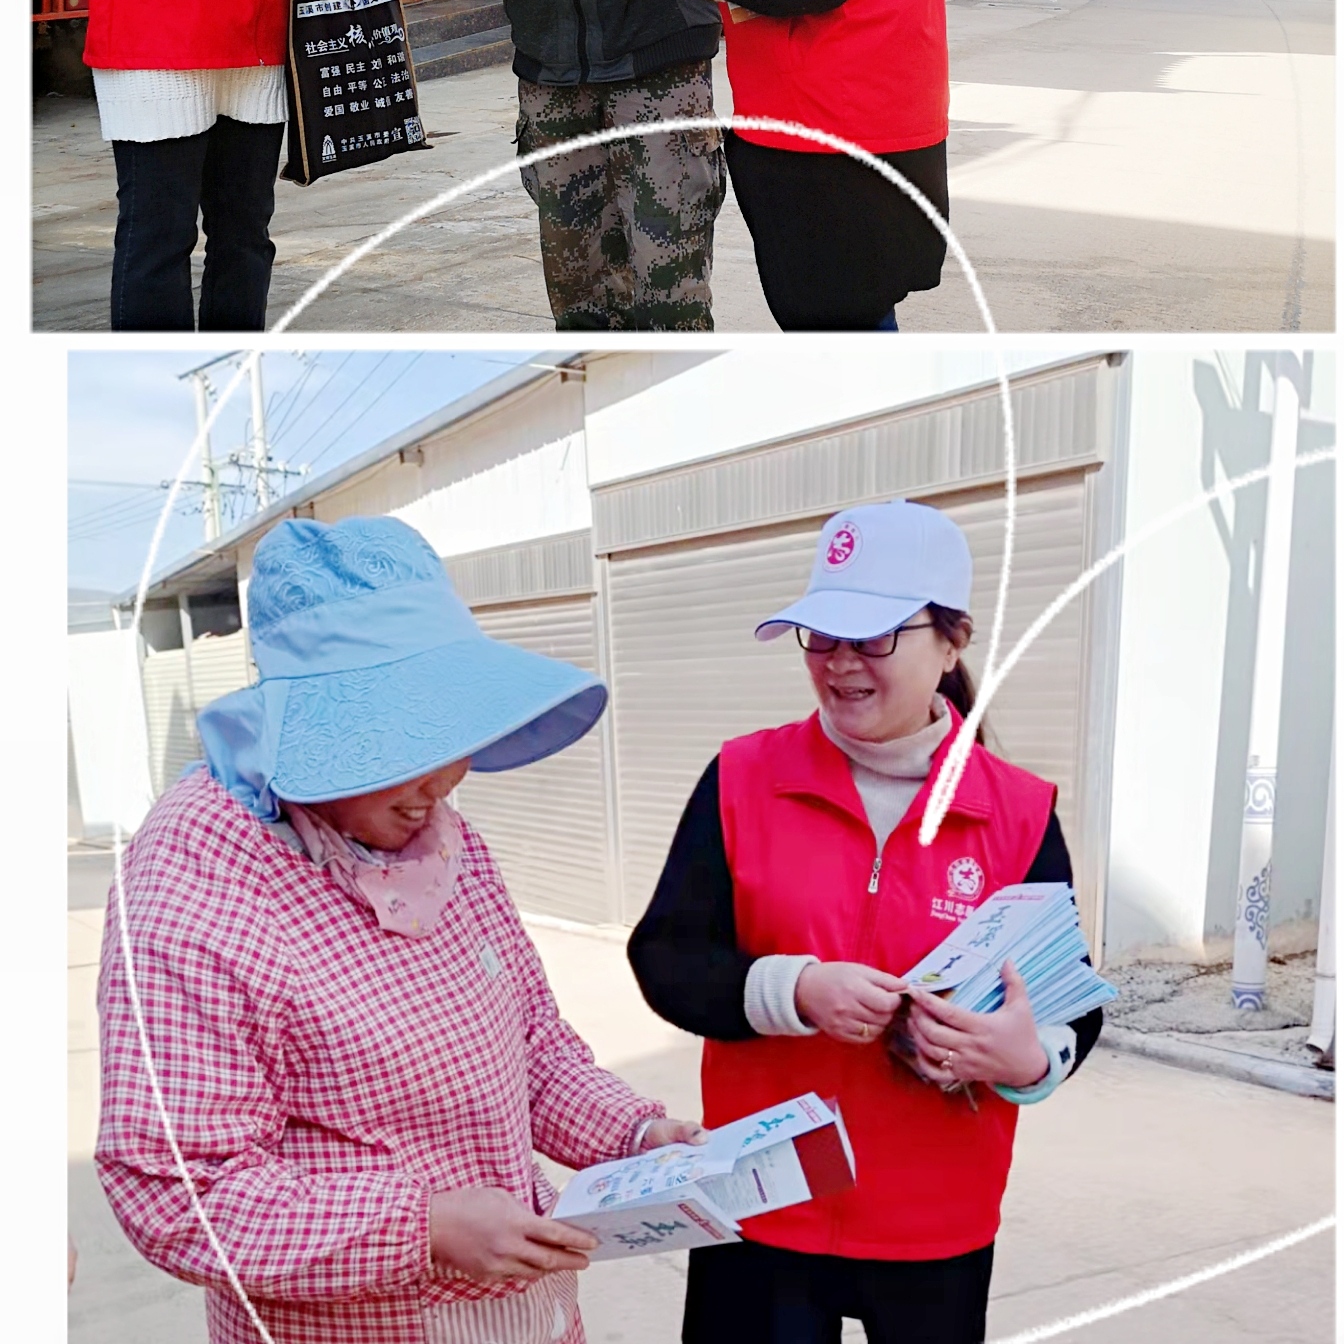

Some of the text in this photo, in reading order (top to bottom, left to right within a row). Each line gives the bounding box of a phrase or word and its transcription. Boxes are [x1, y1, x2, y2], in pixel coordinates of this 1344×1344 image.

[346, 61, 367, 75] 民主
[387, 51, 406, 66] 和谐
[322, 84, 343, 98] 自由
[347, 79, 367, 93] 平等
[390, 69, 410, 84] 法治
[323, 103, 345, 118] 爱国
[349, 99, 370, 113] 敬业
[394, 88, 414, 103] 友善
